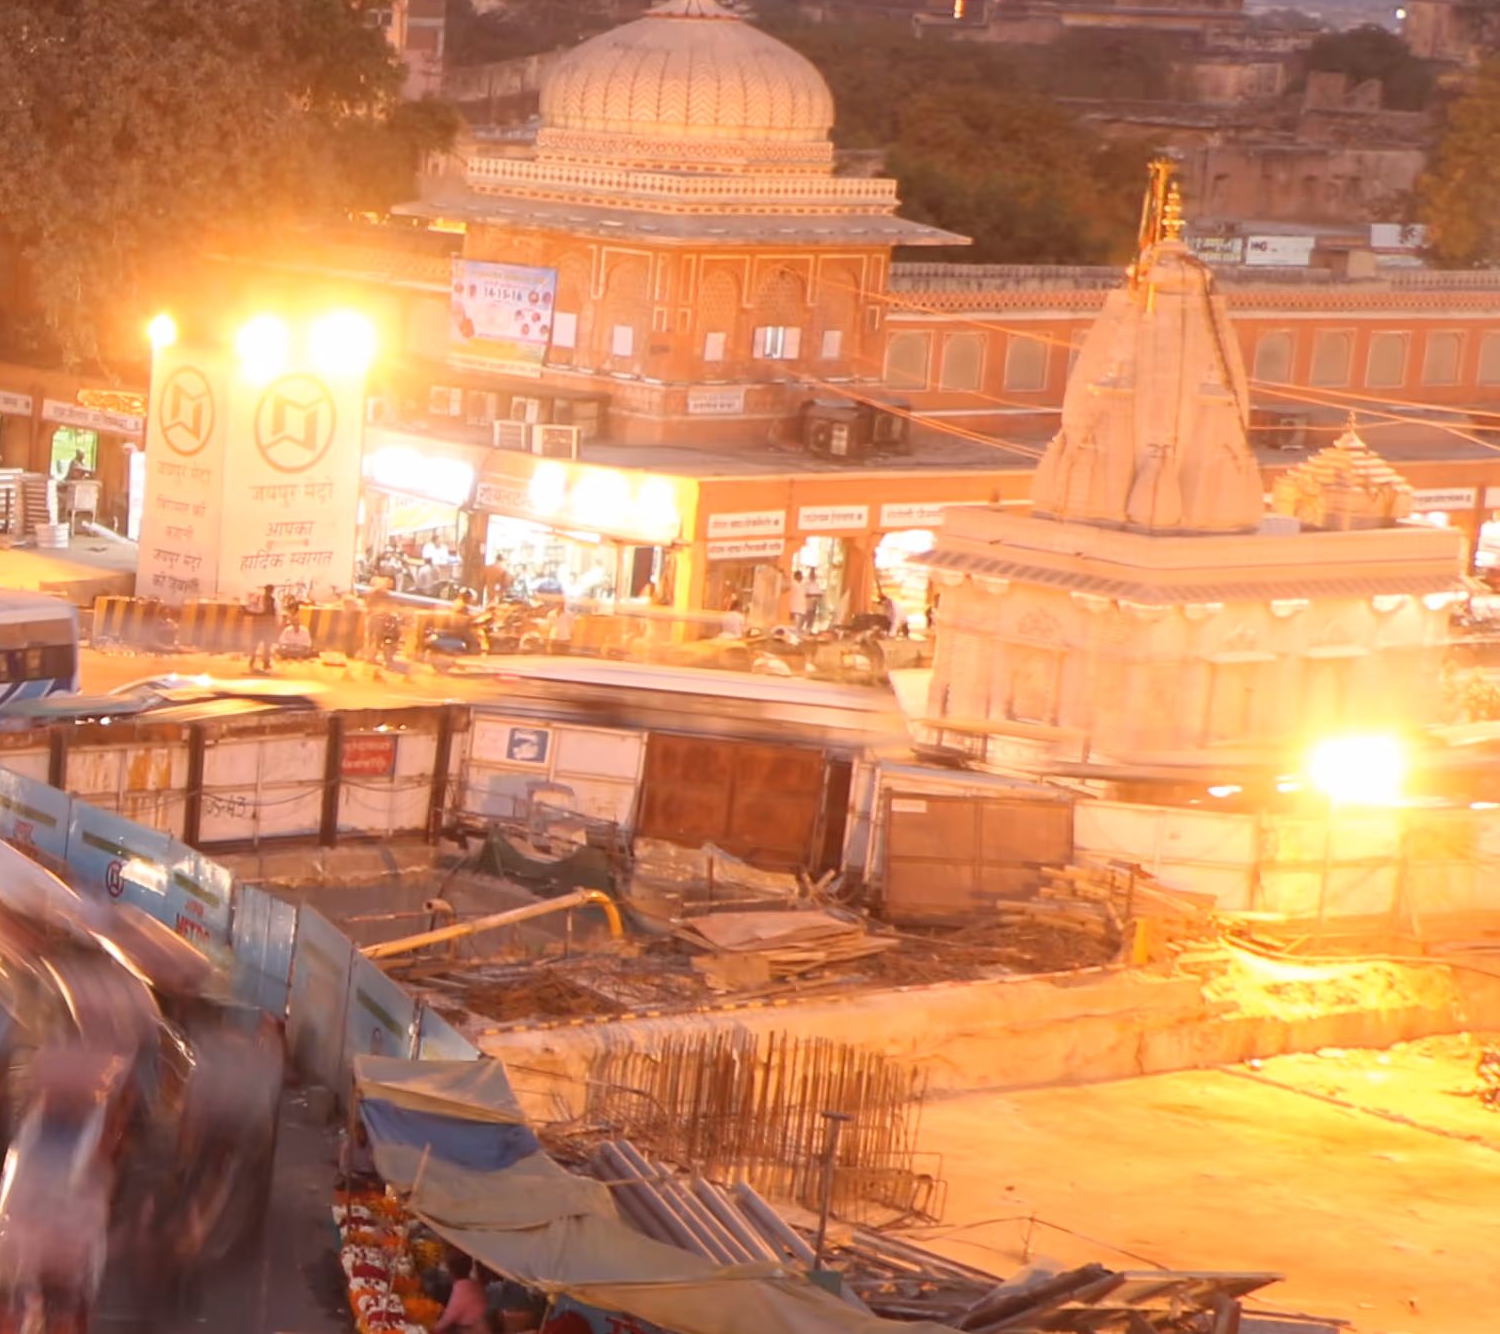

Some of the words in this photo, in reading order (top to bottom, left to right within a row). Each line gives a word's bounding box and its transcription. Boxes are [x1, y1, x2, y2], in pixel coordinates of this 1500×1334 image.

[265, 520, 316, 538] आपका
[240, 548, 286, 573] हार्दिक
[290, 551, 334, 567] स्वागत
